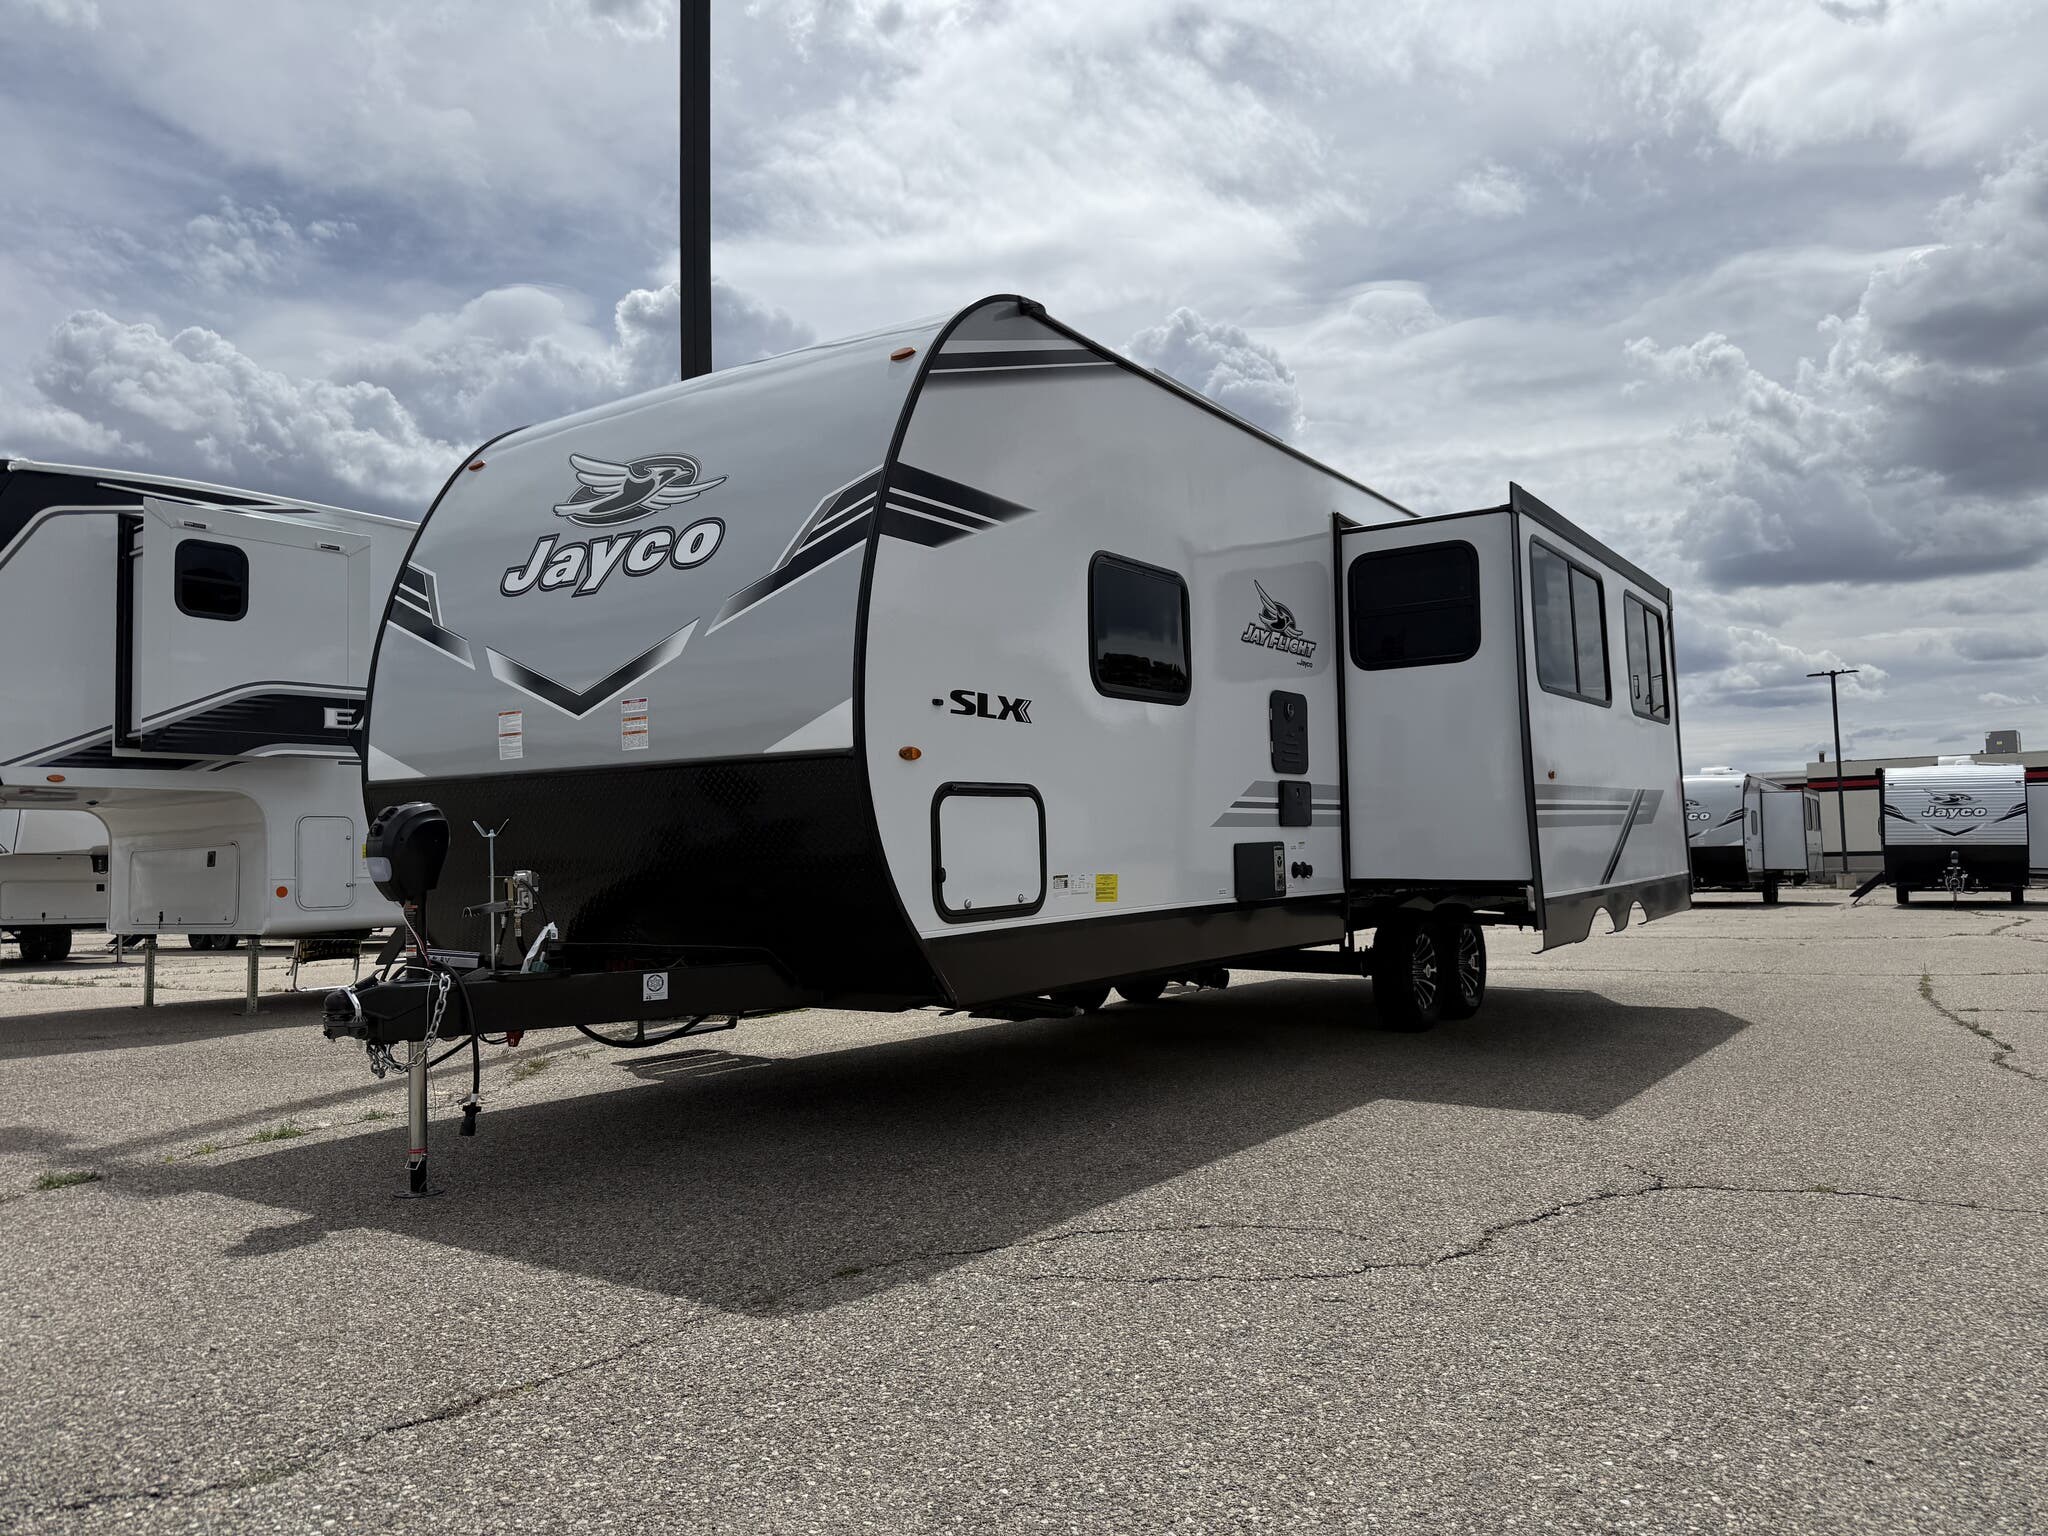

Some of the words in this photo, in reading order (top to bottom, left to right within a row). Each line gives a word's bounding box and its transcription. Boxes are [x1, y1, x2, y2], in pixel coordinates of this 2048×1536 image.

[501, 517, 726, 598] Jayco
[323, 706, 365, 730] E
[950, 689, 1032, 724] SLX
[1922, 805, 1988, 819] Jayco
